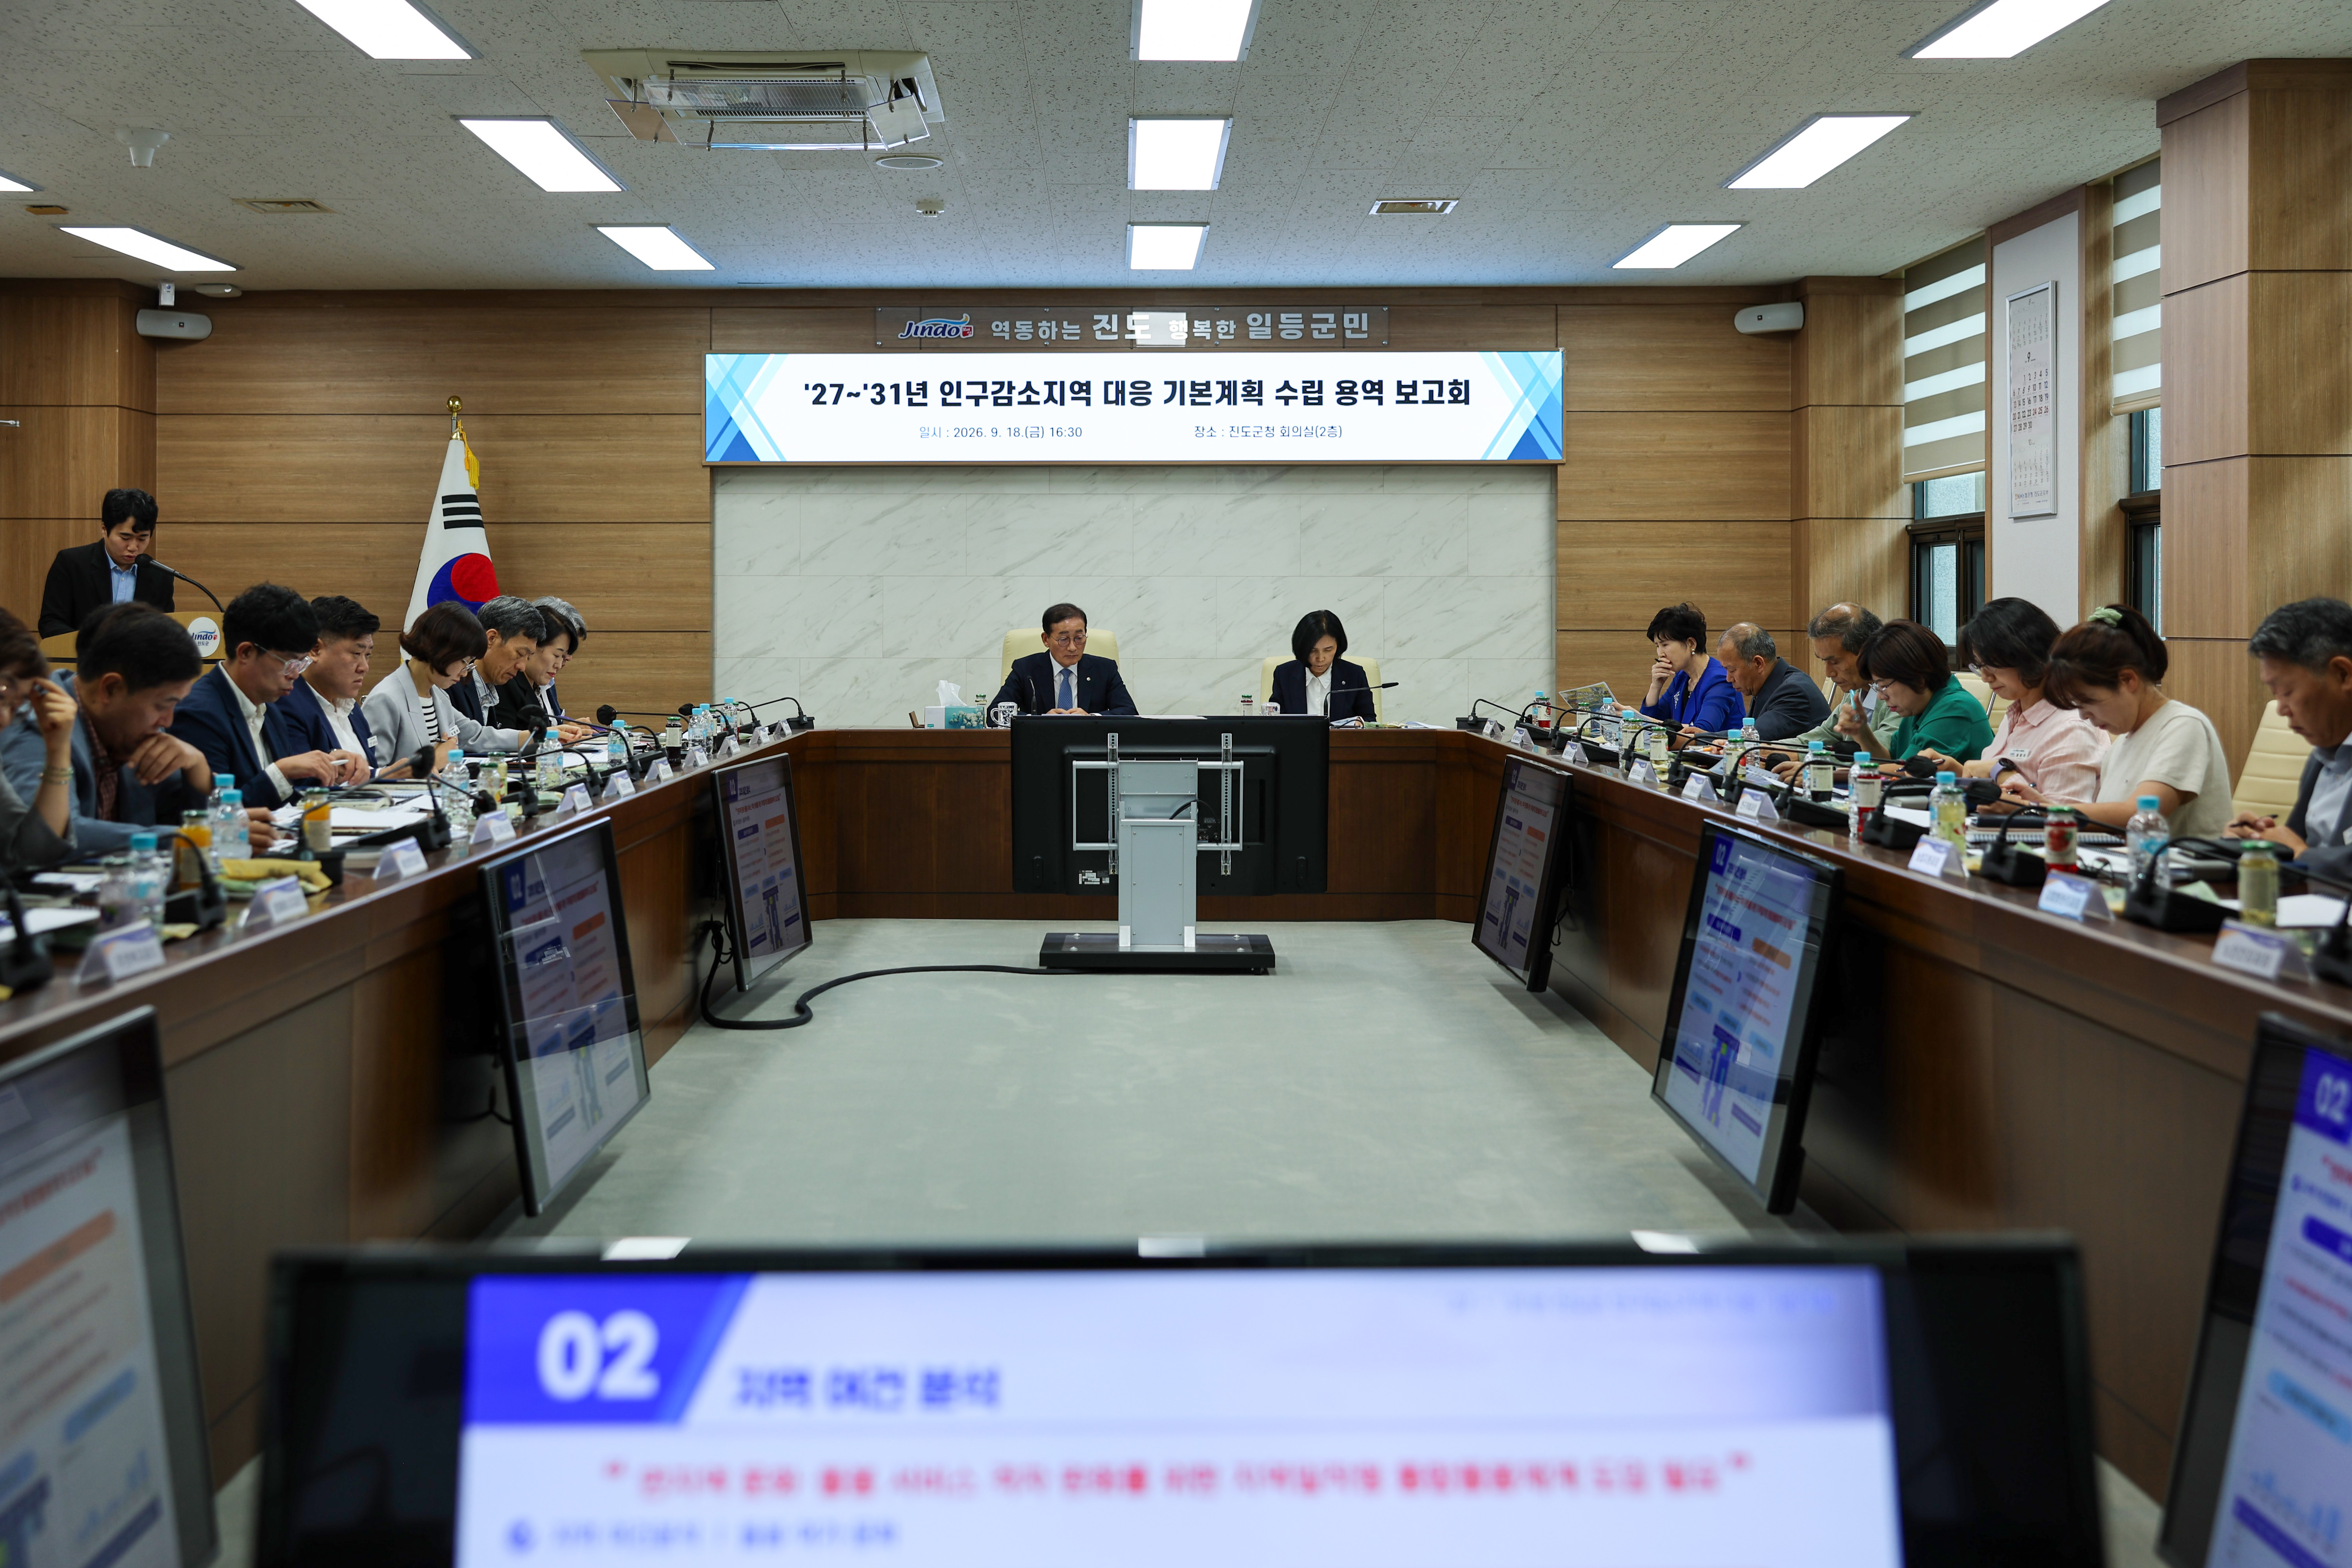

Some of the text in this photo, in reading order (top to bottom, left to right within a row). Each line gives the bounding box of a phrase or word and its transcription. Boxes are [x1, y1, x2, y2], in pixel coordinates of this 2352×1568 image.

[899, 321, 960, 338] Jindo
[991, 321, 1081, 340] 역동하는
[1093, 314, 1151, 340] 진도
[1169, 320, 1236, 340] 행복한
[1247, 313, 1368, 339] 일등군민
[2027, 352, 2031, 362] 9
[805, 379, 1470, 407] '27~'31년 인구감소지역 대응 기본계획 수립 용역 보고회
[920, 426, 941, 438] 일시
[954, 427, 986, 437] 2026.
[991, 427, 1001, 437] 9.
[1007, 426, 1044, 439] 18.(금)
[1050, 427, 1082, 437] 16:30
[1195, 426, 1216, 437] 장소
[1229, 426, 1274, 437] 진도군청
[1280, 425, 1342, 438] 회의실(2층)
[2315, 1074, 2349, 1123] 02
[536, 1310, 660, 1401] 02
